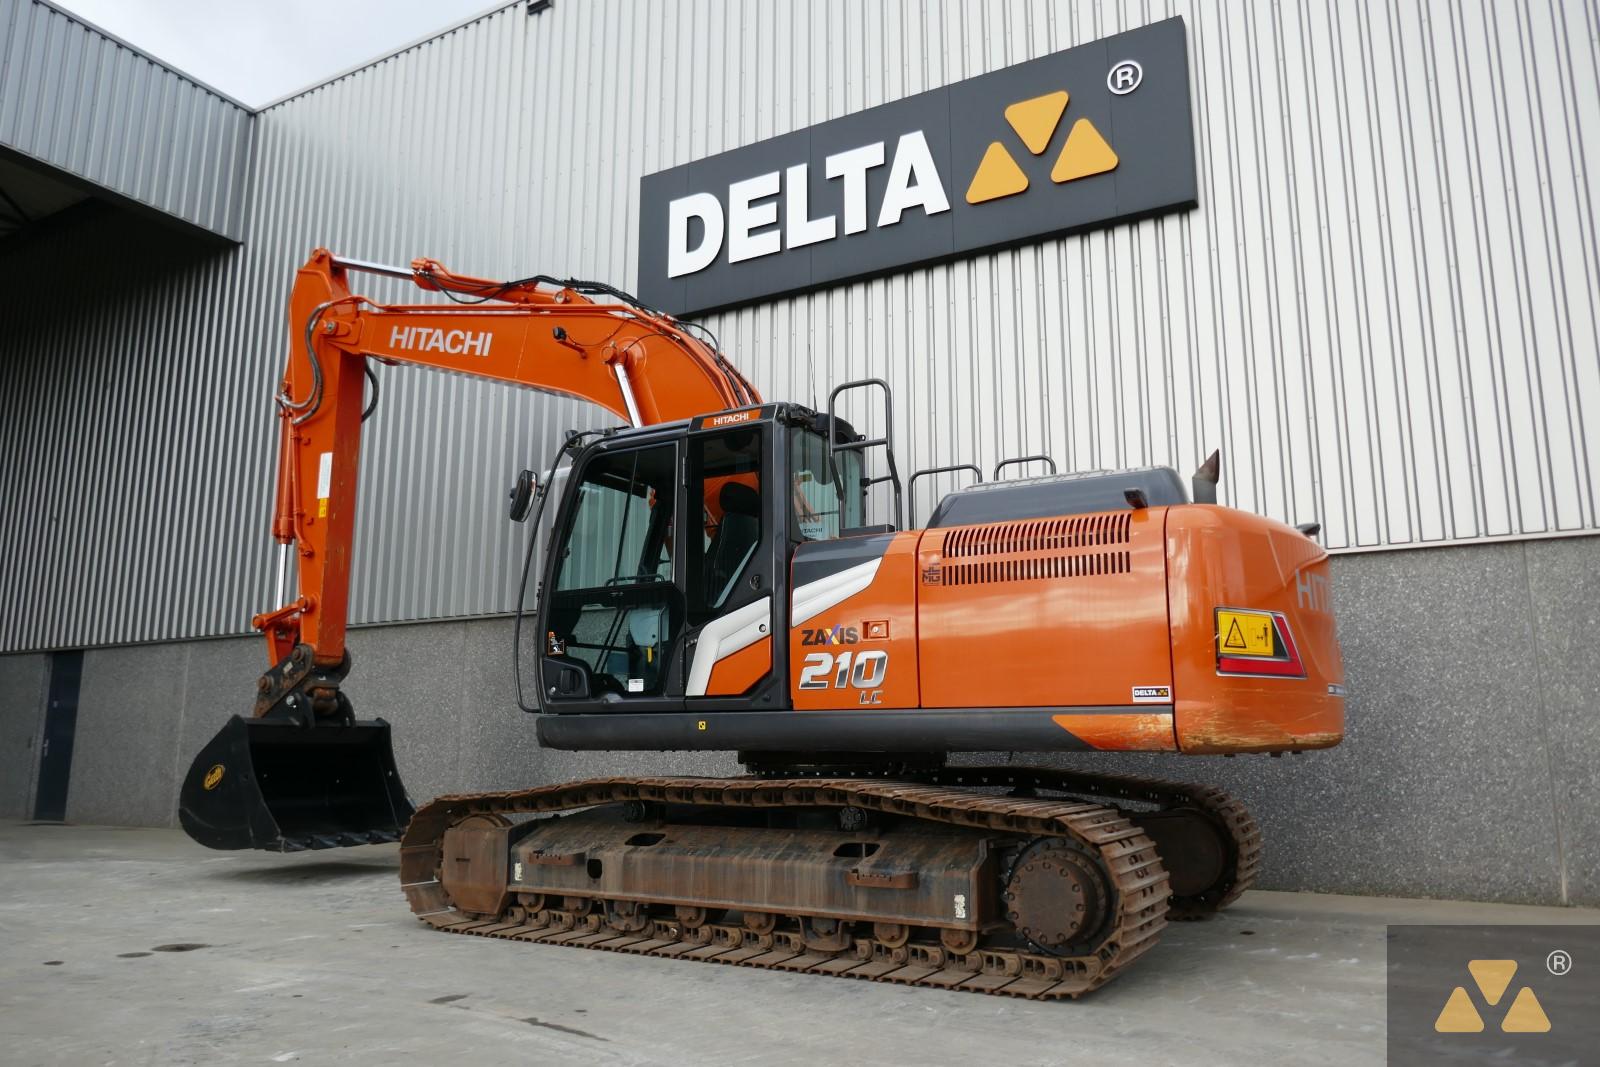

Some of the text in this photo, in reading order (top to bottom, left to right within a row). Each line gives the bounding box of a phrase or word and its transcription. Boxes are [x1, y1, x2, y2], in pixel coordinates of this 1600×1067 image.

[668, 130, 951, 279] DELTA
[389, 325, 493, 357] HITACHI
[713, 412, 749, 426] HITACHI
[801, 623, 859, 646] ZAXIS
[799, 650, 889, 690] 210
[859, 690, 884, 704] LC
